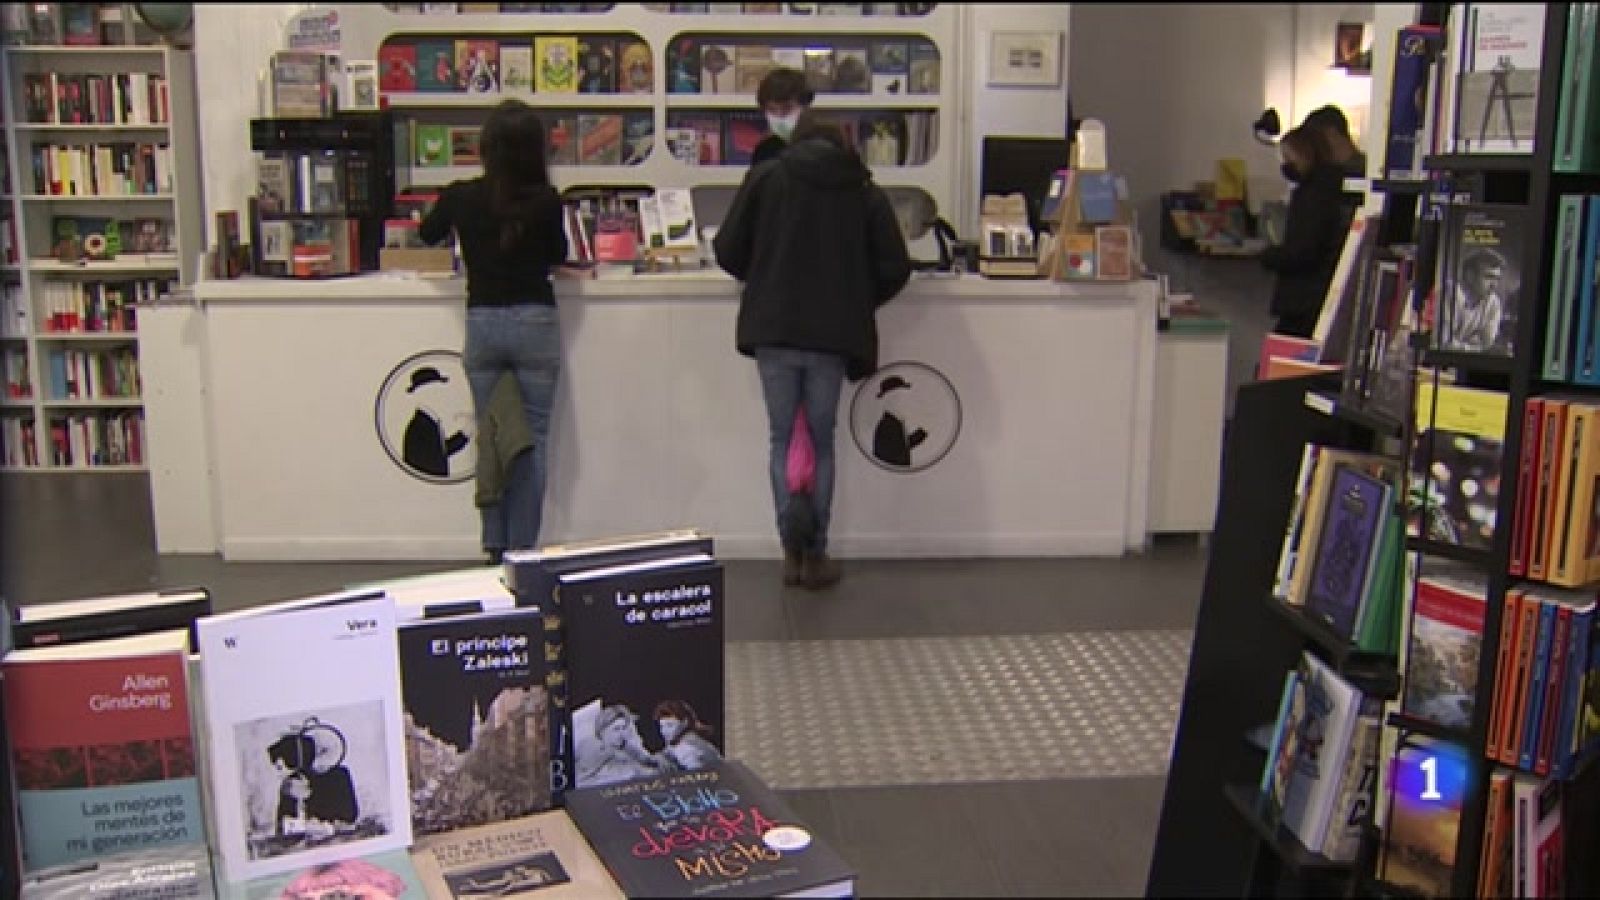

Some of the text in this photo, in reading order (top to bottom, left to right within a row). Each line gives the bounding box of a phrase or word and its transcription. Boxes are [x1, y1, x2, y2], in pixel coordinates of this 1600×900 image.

[615, 584, 711, 606] La escalera
[625, 607, 646, 623] de
[652, 599, 711, 621] caracol
[346, 618, 378, 631] Vera
[432, 639, 450, 655] El
[464, 651, 528, 671] Zaleski
[122, 673, 169, 691] Allen
[89, 692, 171, 711] Ginsberg
[81, 795, 184, 816] Las mejores
[95, 810, 186, 832] mentes de
[66, 825, 188, 853] mi generación
